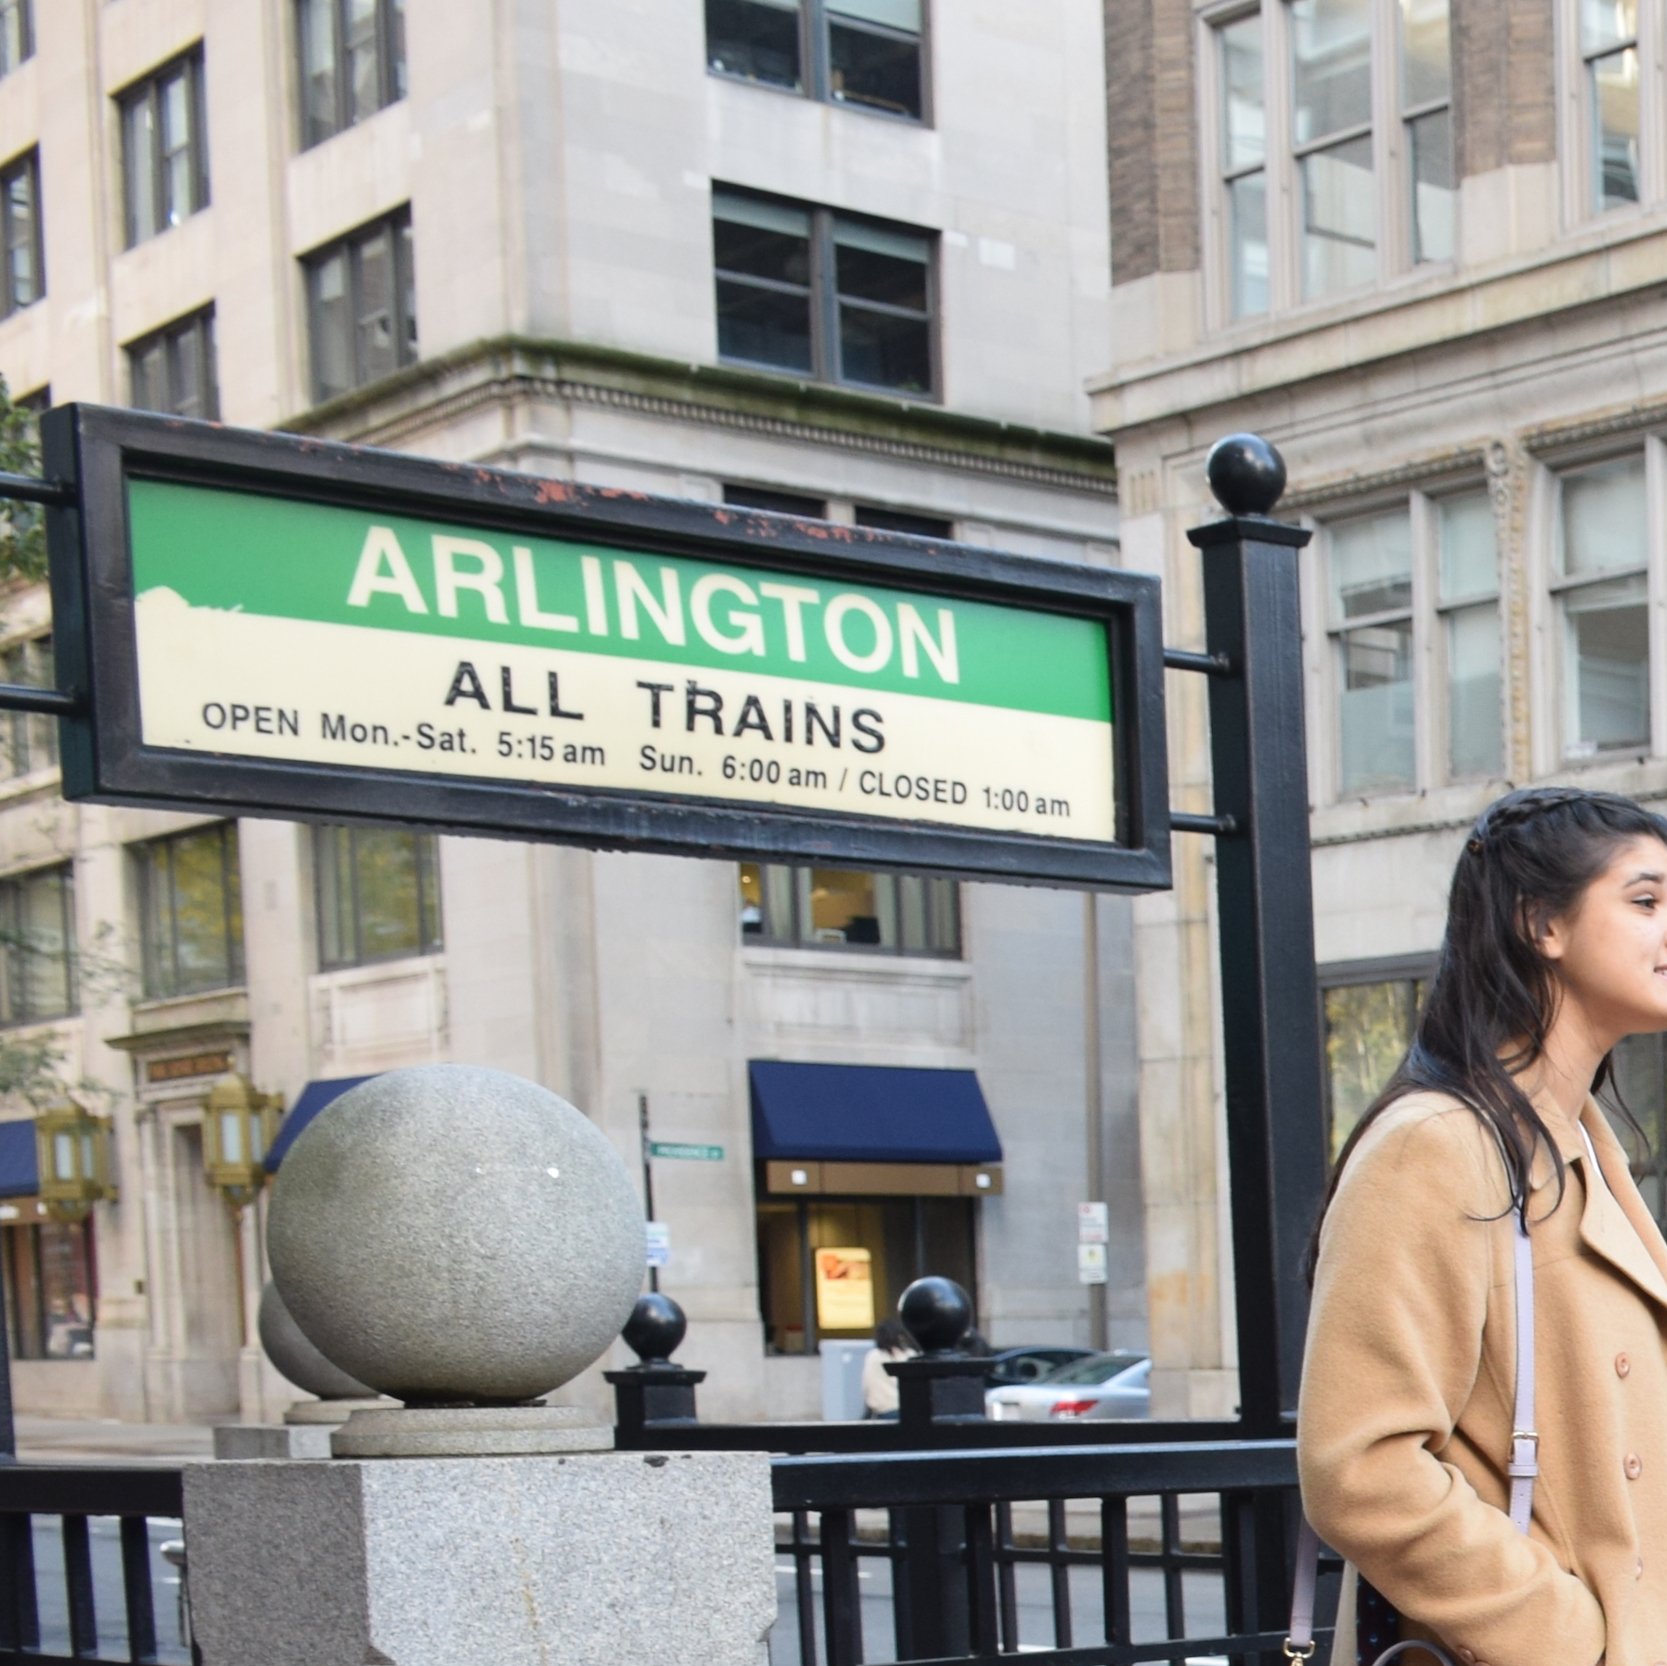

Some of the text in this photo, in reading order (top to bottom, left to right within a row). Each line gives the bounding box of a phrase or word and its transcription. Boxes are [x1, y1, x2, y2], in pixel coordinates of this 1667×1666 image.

[347, 525, 960, 684] ARLINGTON
[202, 702, 299, 737] OPEN
[321, 712, 477, 754] Mon.-Sat.
[498, 732, 555, 761] 5:15
[563, 741, 606, 766] am
[639, 745, 703, 776] Sun.
[721, 754, 781, 784] 6:00
[788, 767, 827, 789] am
[858, 770, 968, 805] CLOSED
[982, 786, 1029, 813] 1:00
[1035, 796, 1071, 817] am
[444, 660, 886, 754] ALL TRAINS
